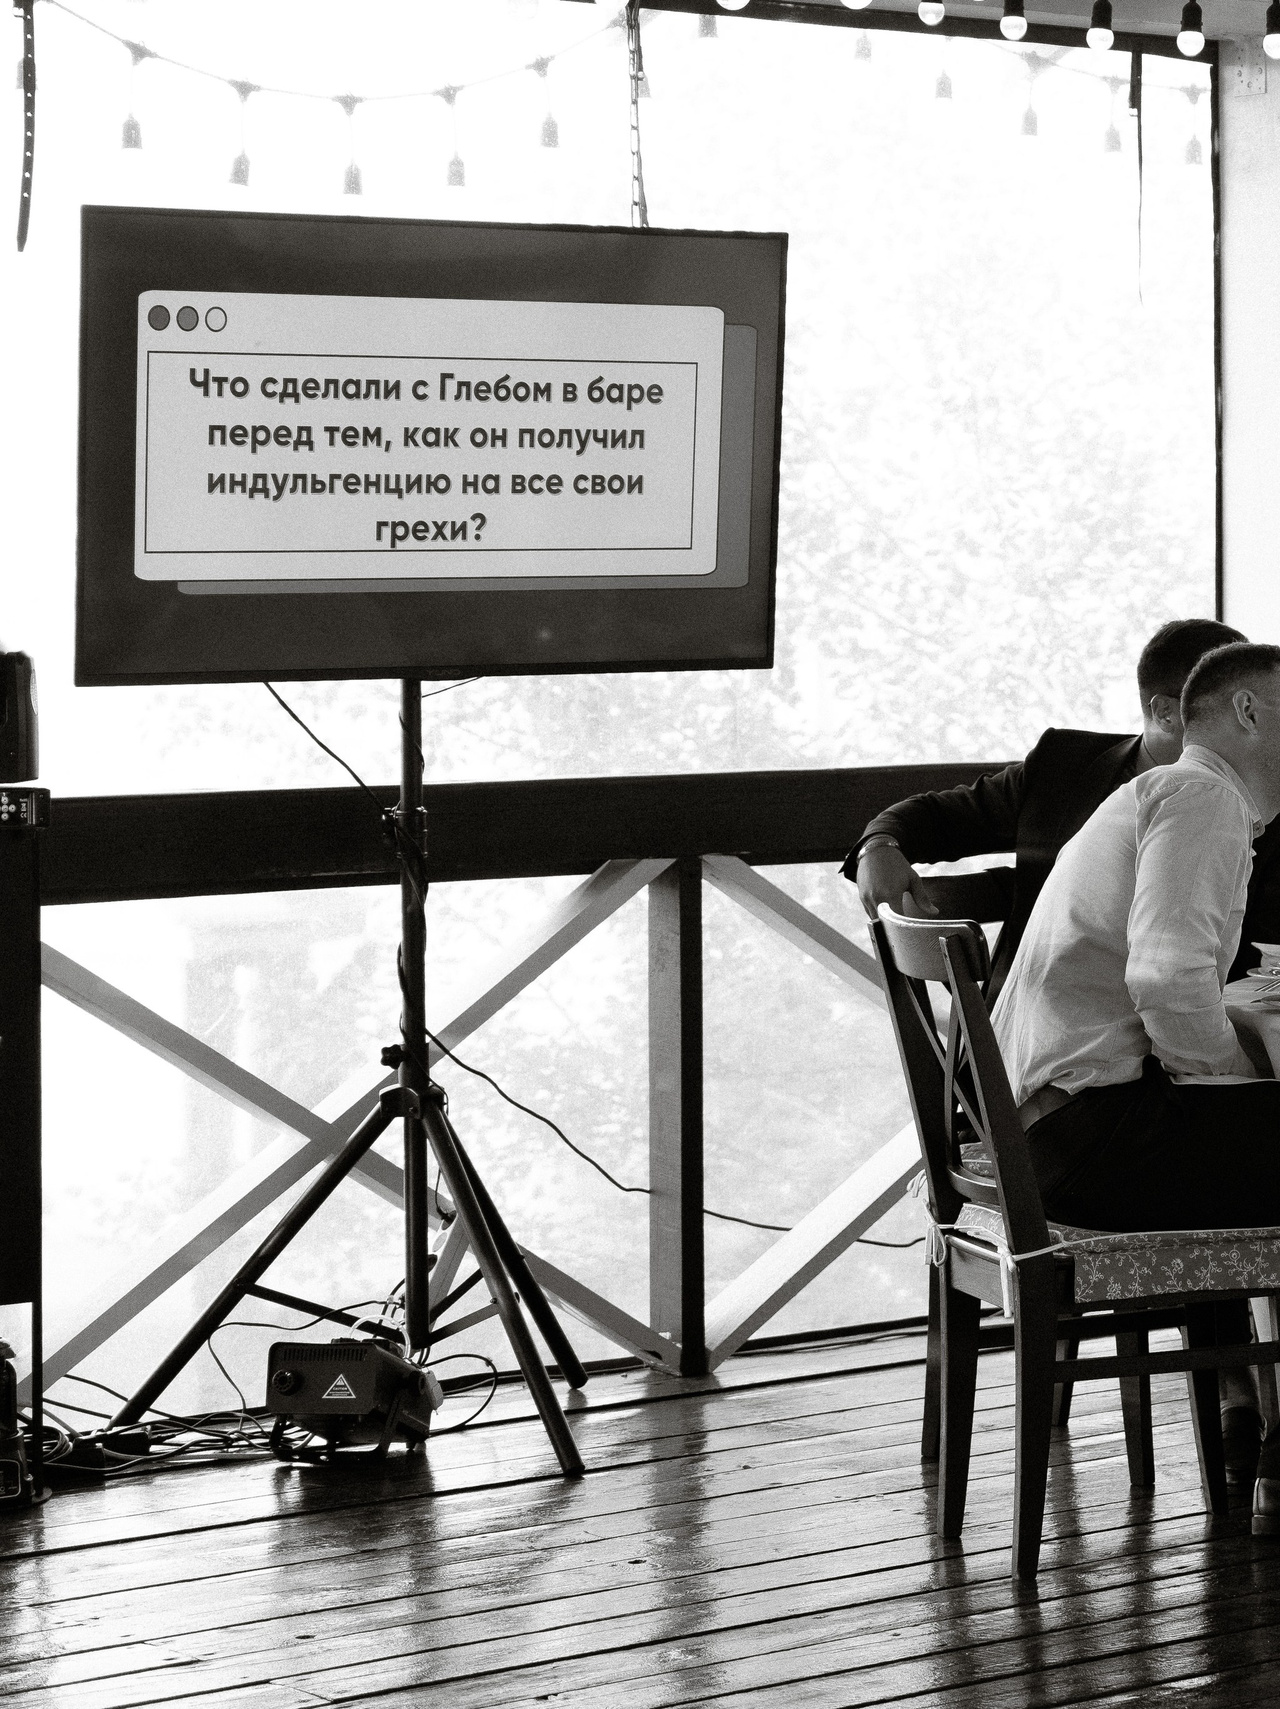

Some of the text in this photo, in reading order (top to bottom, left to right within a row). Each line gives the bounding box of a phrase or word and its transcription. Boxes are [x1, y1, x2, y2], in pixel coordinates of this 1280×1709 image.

[189, 368, 664, 411] Что сделали с Глебом в баре
[208, 424, 645, 456] перед тем, как он получил
[207, 473, 643, 501] индульгенцию на все свои
[376, 512, 487, 547] грехи?
